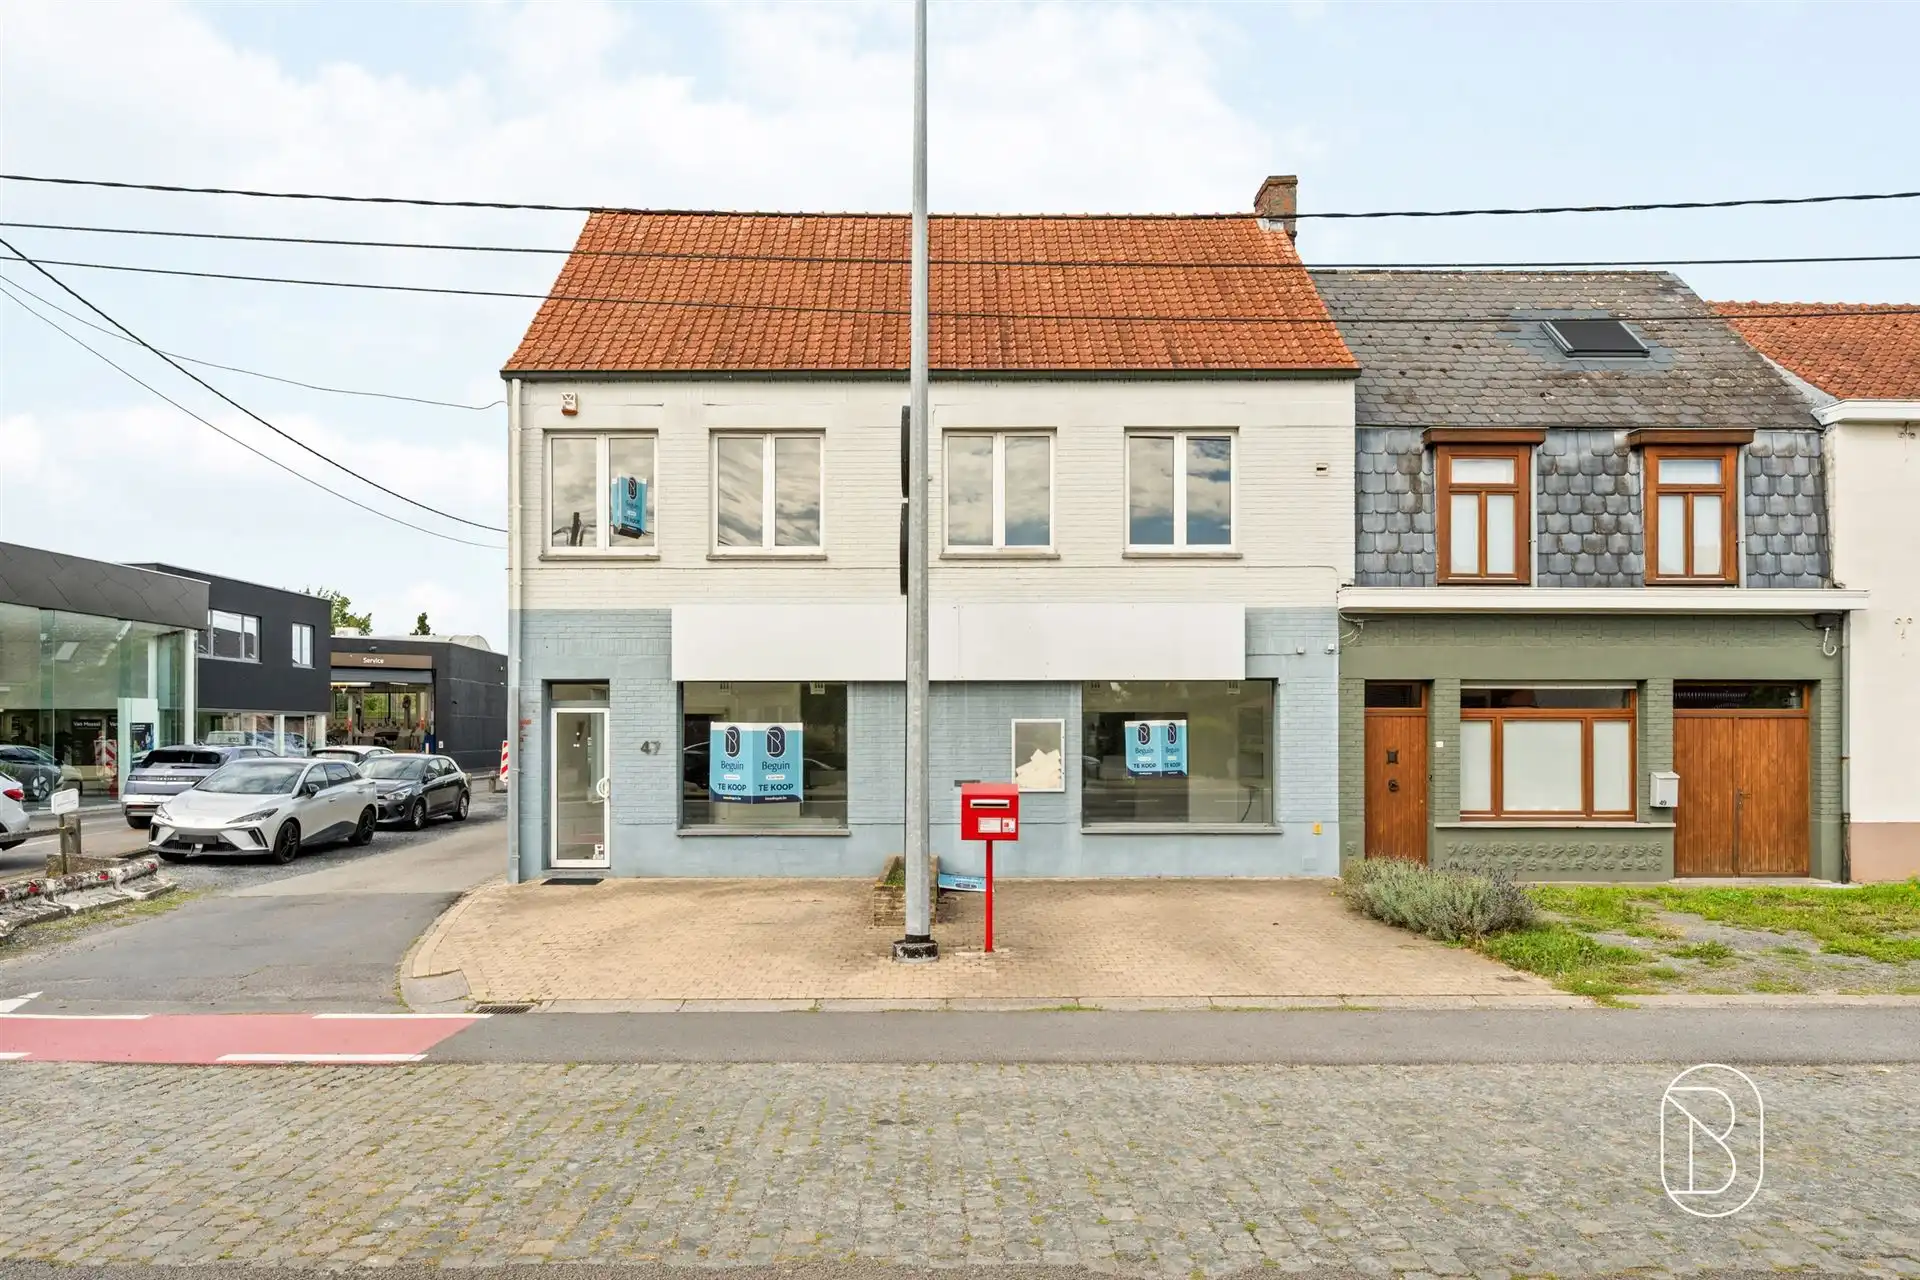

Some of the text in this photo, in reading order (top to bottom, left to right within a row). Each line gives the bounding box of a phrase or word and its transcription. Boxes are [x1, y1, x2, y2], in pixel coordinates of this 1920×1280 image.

[362, 656, 385, 664] Service
[640, 740, 661, 756] 47
[720, 760, 744, 772] Beguin
[761, 760, 790, 772] Beguin
[717, 782, 747, 791] TE KOOP
[758, 783, 794, 792] TE KOOP
